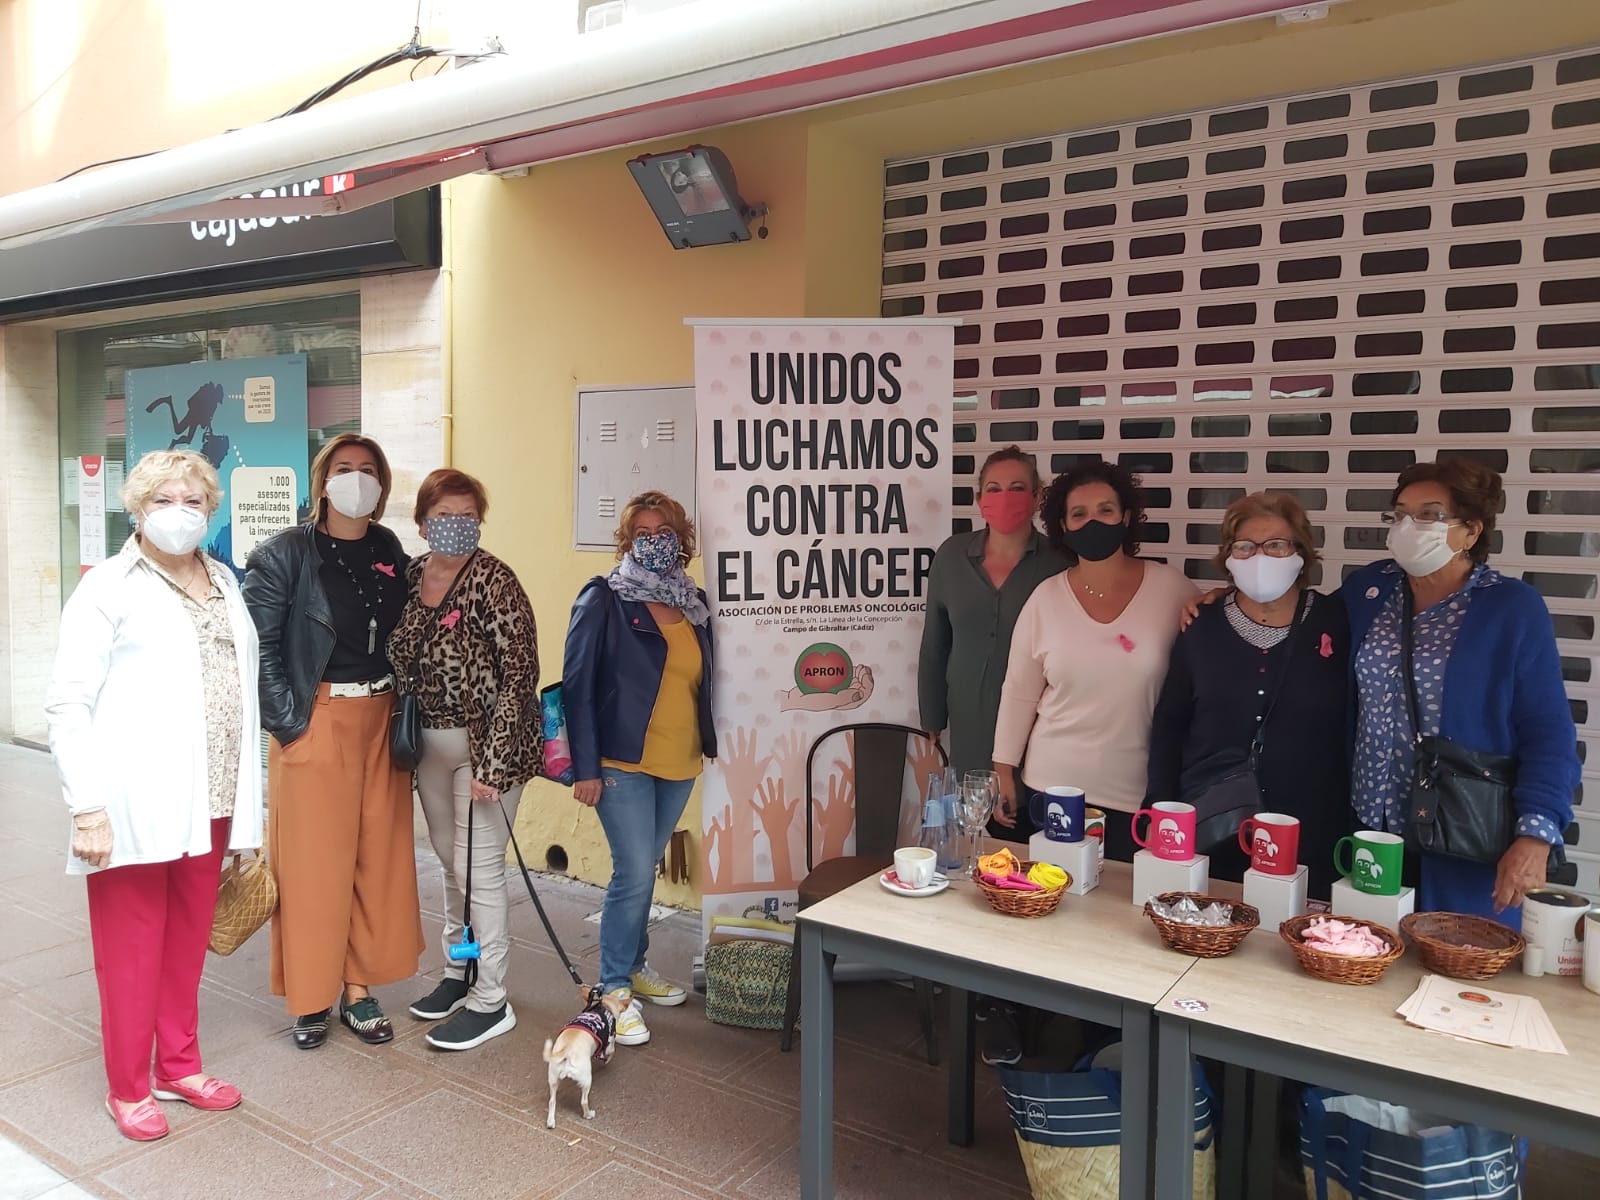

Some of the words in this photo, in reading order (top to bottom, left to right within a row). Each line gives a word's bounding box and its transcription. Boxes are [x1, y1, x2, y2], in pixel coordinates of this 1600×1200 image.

[750, 352, 902, 405] UNIDOS
[713, 418, 939, 471] LUCHAMOS
[270, 476, 290, 486] 1.000
[257, 490, 290, 499] asesores
[238, 501, 290, 512] especializados
[746, 483, 909, 536] CONTRA
[240, 515, 256, 524] para
[257, 514, 290, 524] ofrecerte
[249, 526, 256, 536] la
[717, 550, 765, 602] EL
[776, 538, 937, 600] CÁNCER
[718, 604, 782, 617] ASOCIACIÓN
[784, 605, 798, 615] DE
[800, 603, 862, 614] PROBLEMAS
[864, 602, 927, 612] ONCOLÓGIC
[864, 614, 903, 624] Concepción
[804, 666, 845, 678] APRON
